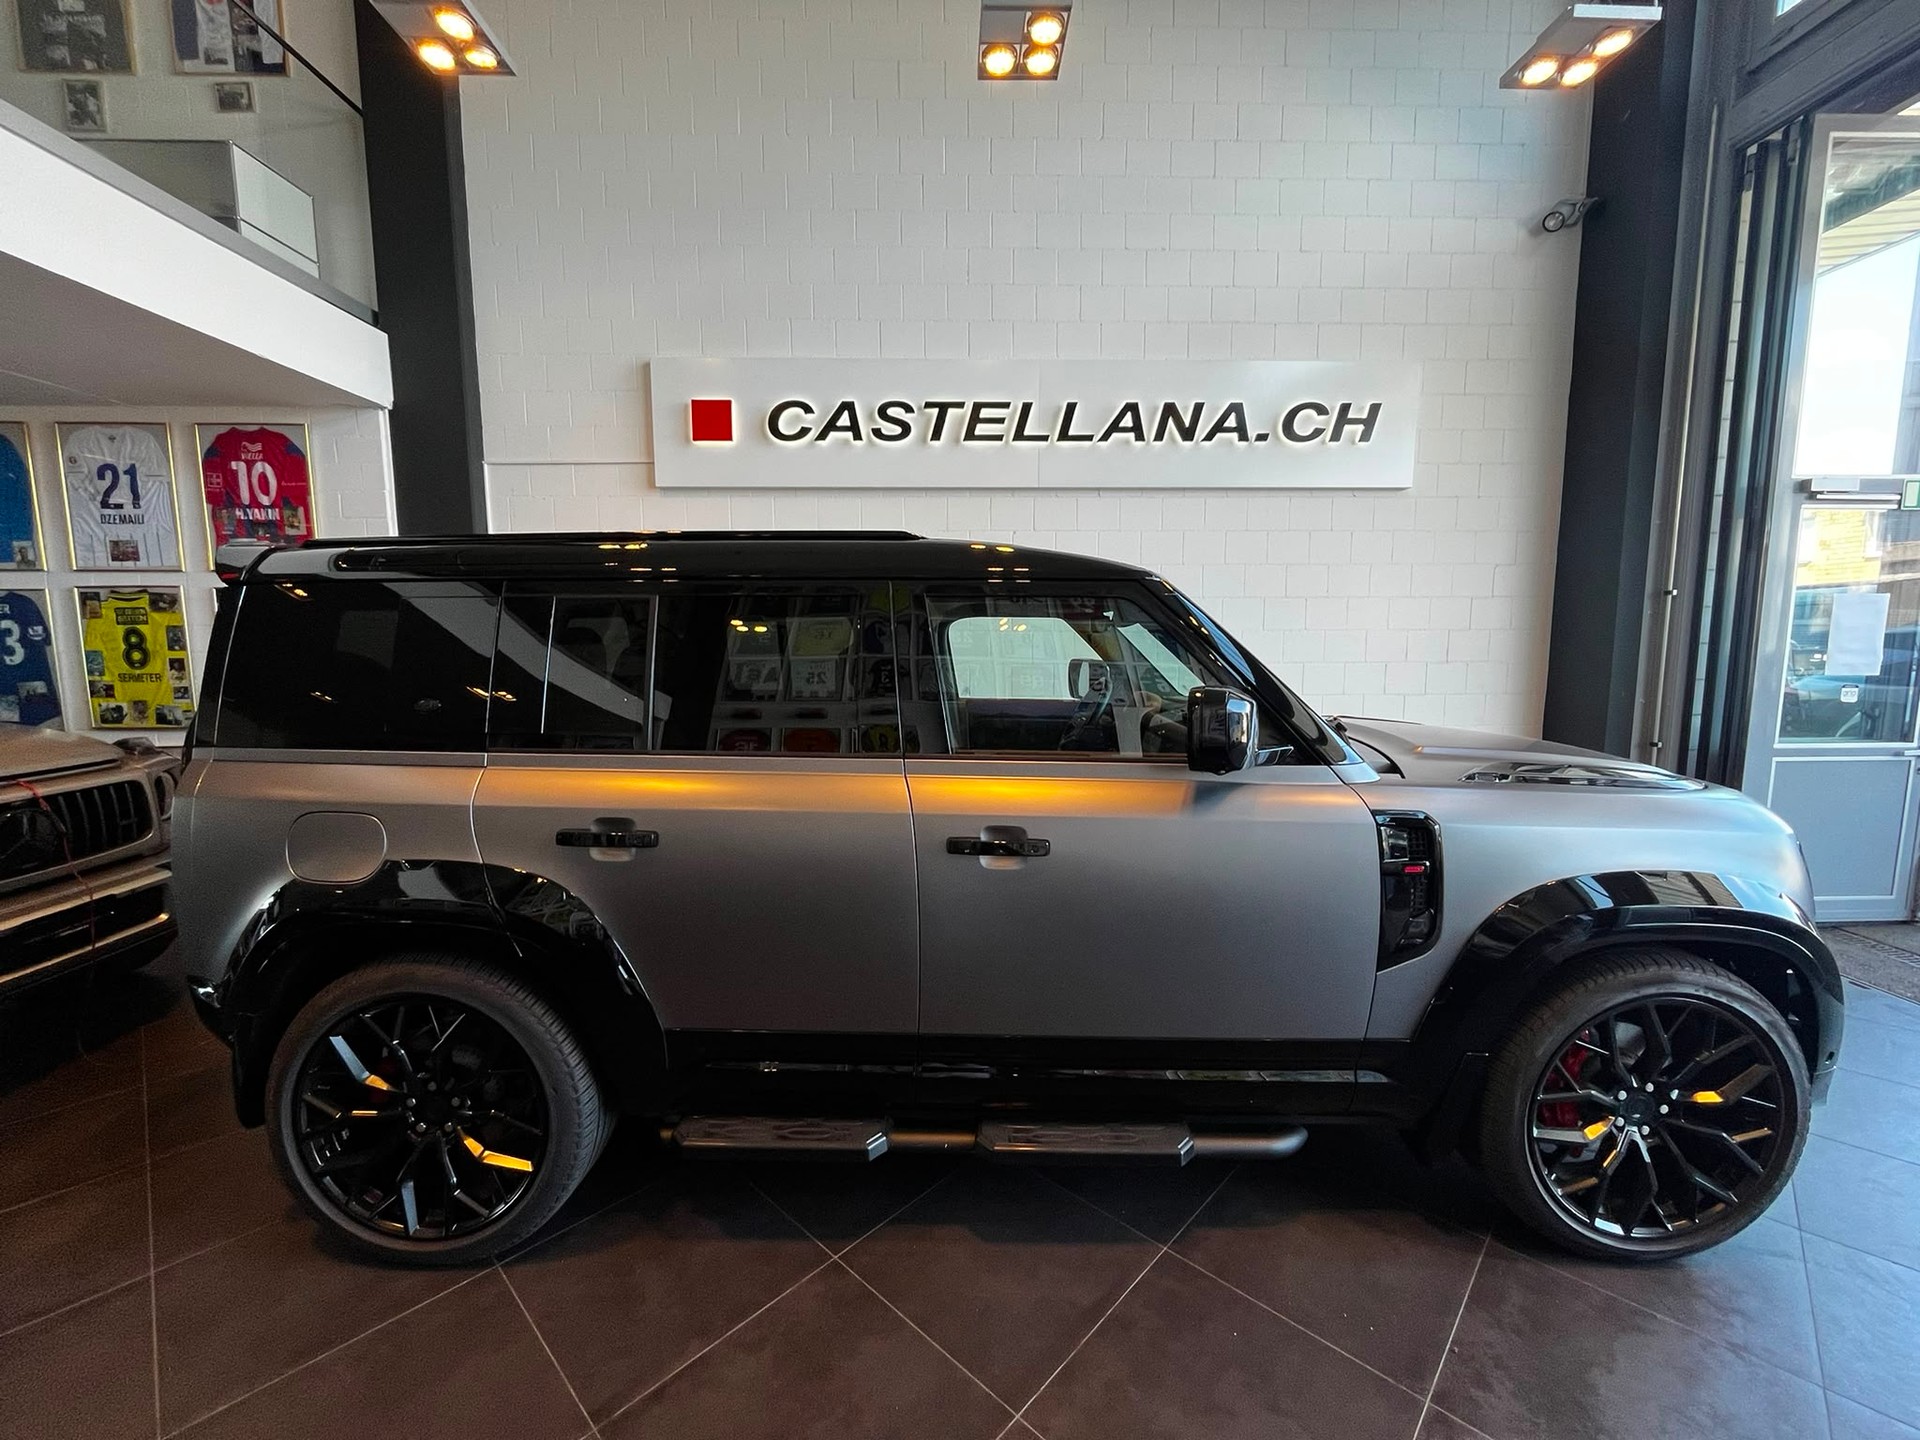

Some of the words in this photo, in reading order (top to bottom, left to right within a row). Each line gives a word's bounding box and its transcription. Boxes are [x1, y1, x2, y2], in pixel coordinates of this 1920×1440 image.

[766, 400, 1383, 443] CASTELLANA.CH
[97, 463, 141, 509] 21
[230, 460, 277, 506] 10
[122, 626, 151, 671] 8
